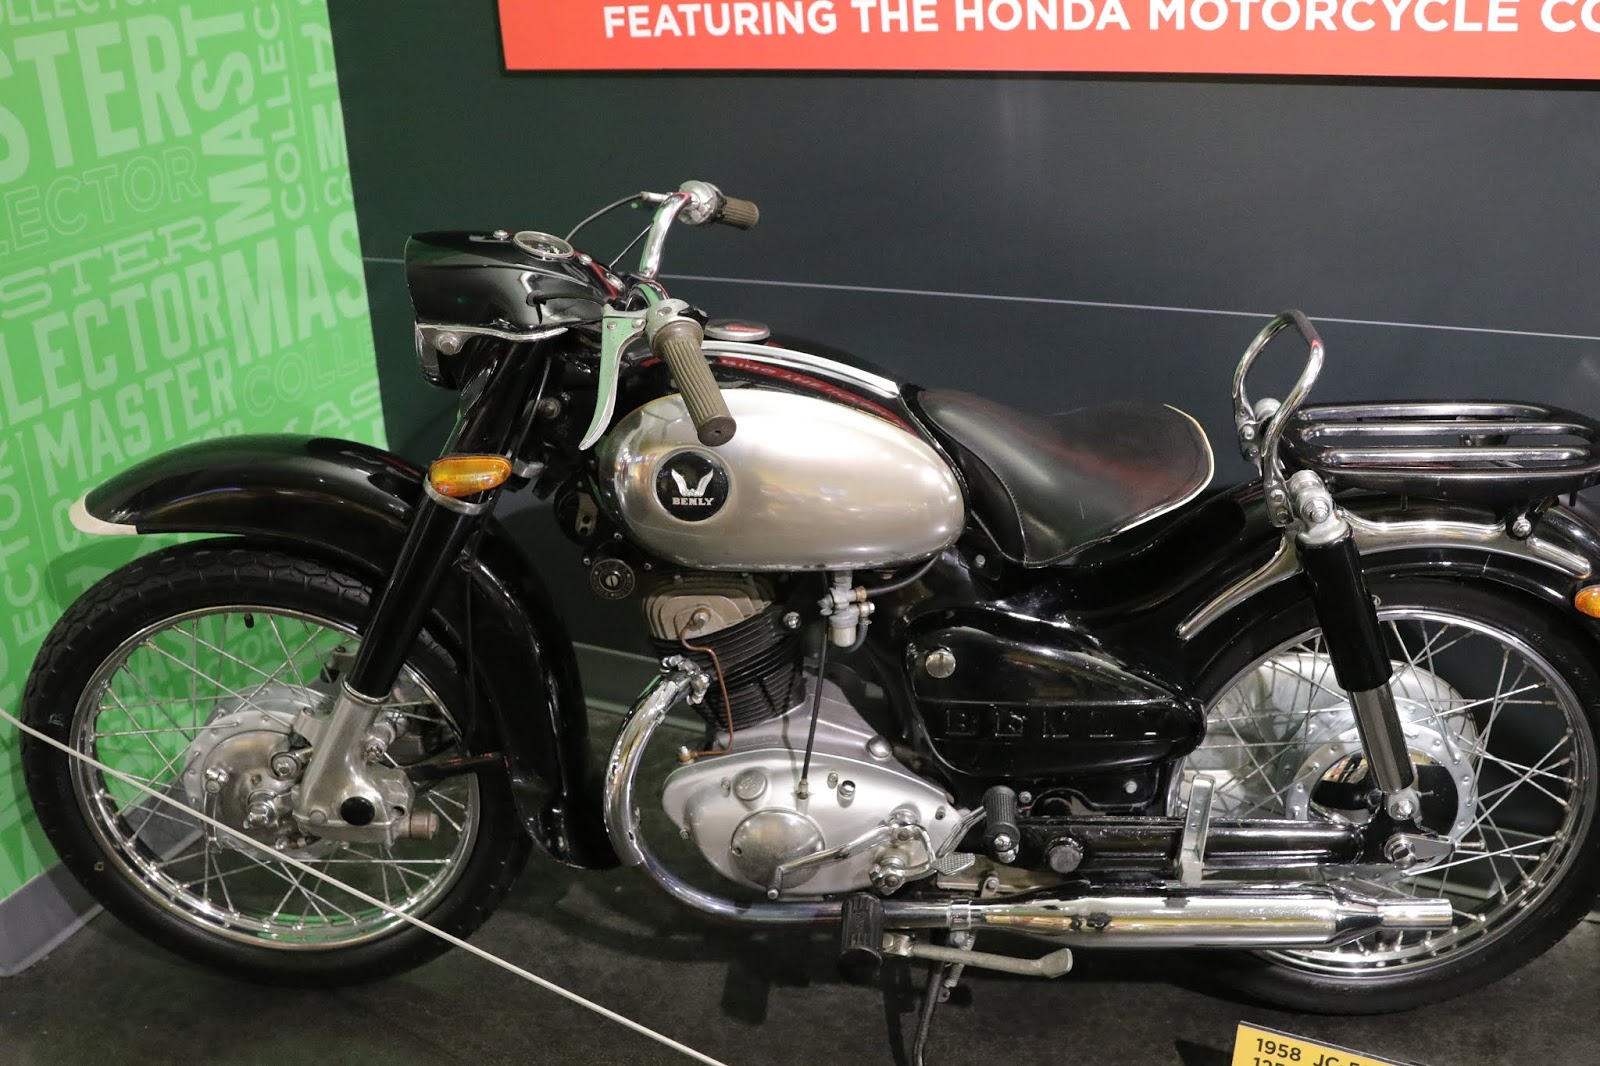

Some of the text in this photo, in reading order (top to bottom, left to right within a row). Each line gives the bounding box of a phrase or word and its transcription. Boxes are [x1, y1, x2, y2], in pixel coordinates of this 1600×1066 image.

[603, 1, 837, 39] FEATURING
[851, 0, 939, 34] THE
[955, 0, 1132, 32] HONDA
[1149, 0, 1520, 33] MOTORCYCLE
[33, 348, 239, 496] MASTER
[672, 497, 715, 506] BENLY
[1256, 1038, 1302, 1062] 1958
